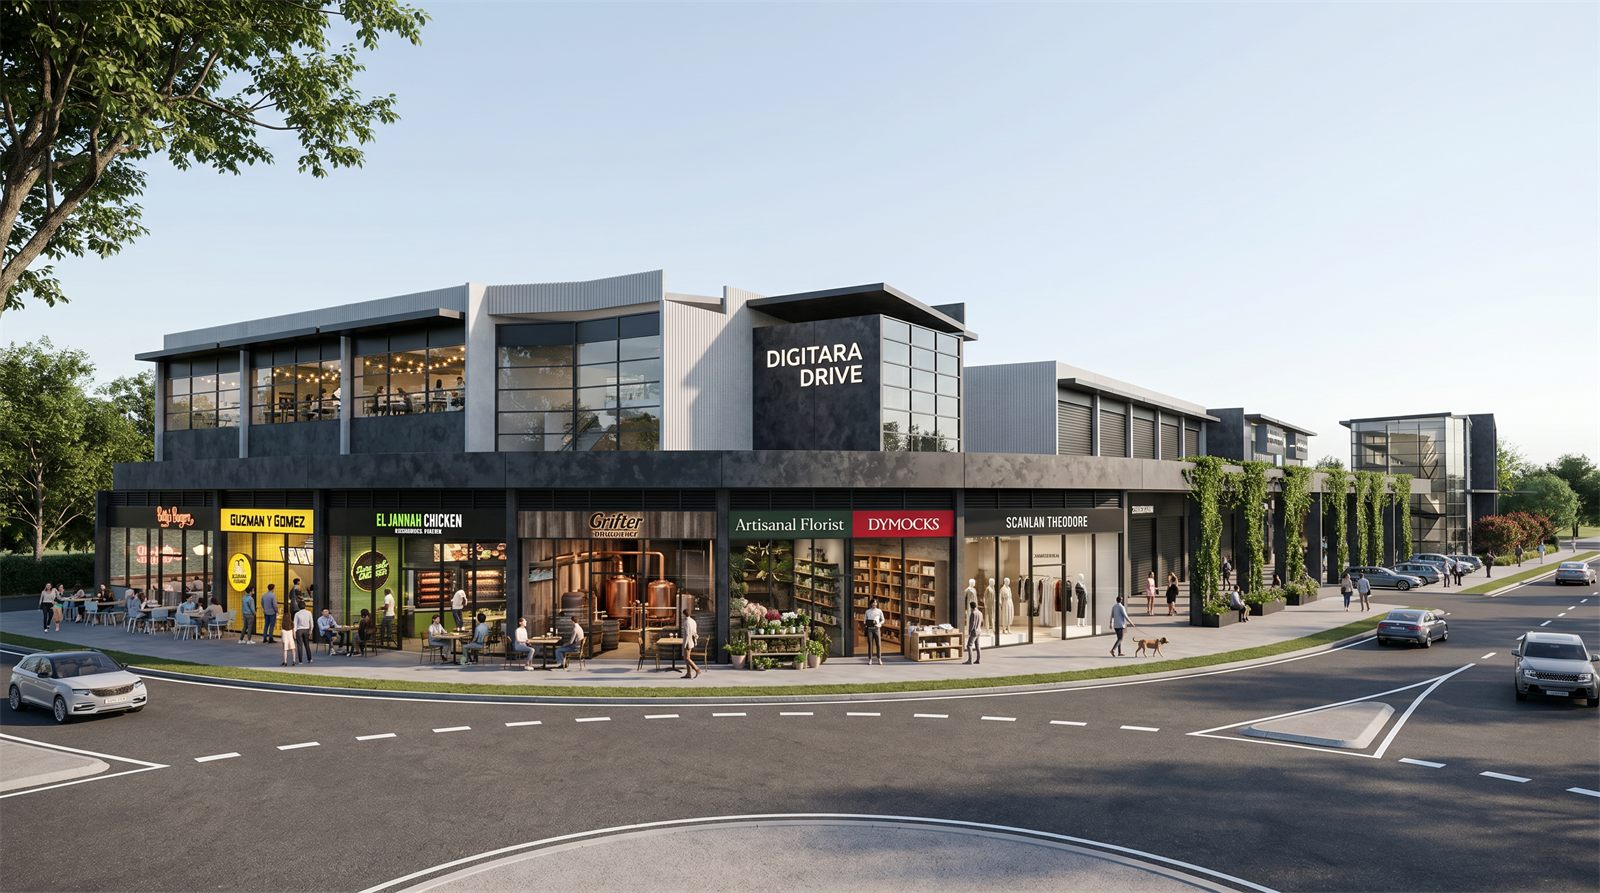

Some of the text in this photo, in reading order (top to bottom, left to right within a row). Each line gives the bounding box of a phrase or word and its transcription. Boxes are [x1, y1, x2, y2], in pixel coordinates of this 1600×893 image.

[767, 342, 863, 368] DIGITARA
[800, 364, 863, 387] DRIVE
[230, 514, 305, 528] GUZMAN Y GOMEZ
[376, 513, 463, 528] EL JANNAH CHICKEN
[589, 512, 644, 529] Grifter
[735, 518, 844, 531] Artisanal Florist
[868, 518, 940, 531] DYMOCKS
[1006, 515, 1088, 529] SCANLAN THEODORE
